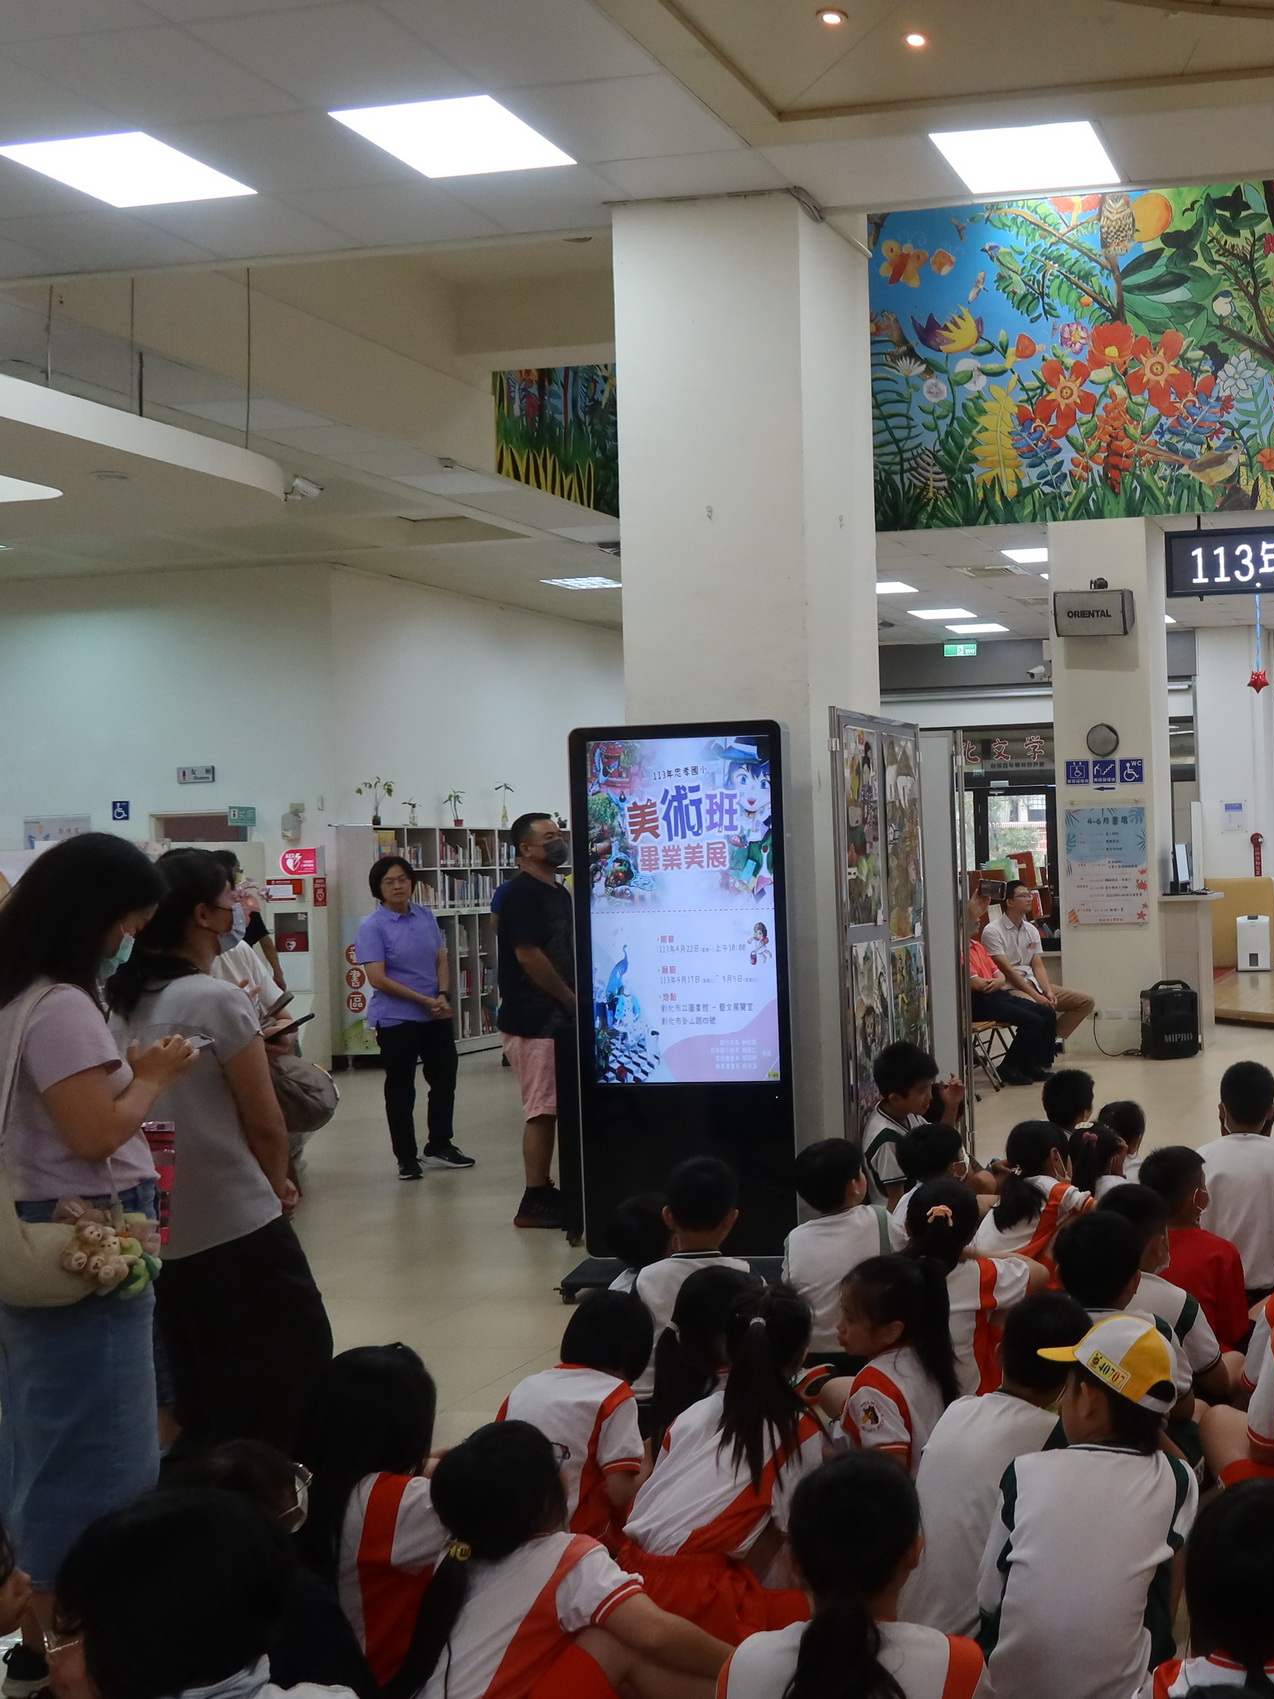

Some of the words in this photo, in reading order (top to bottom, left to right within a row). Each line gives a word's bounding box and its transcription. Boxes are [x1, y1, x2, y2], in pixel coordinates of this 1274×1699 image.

[1067, 610, 1111, 618] ORIENTAL
[626, 784, 739, 843] 美術班
[639, 841, 727, 872] 畢業美展
[1164, 1033, 1193, 1042] MIPRO
[1099, 1361, 1126, 1387] 40707
